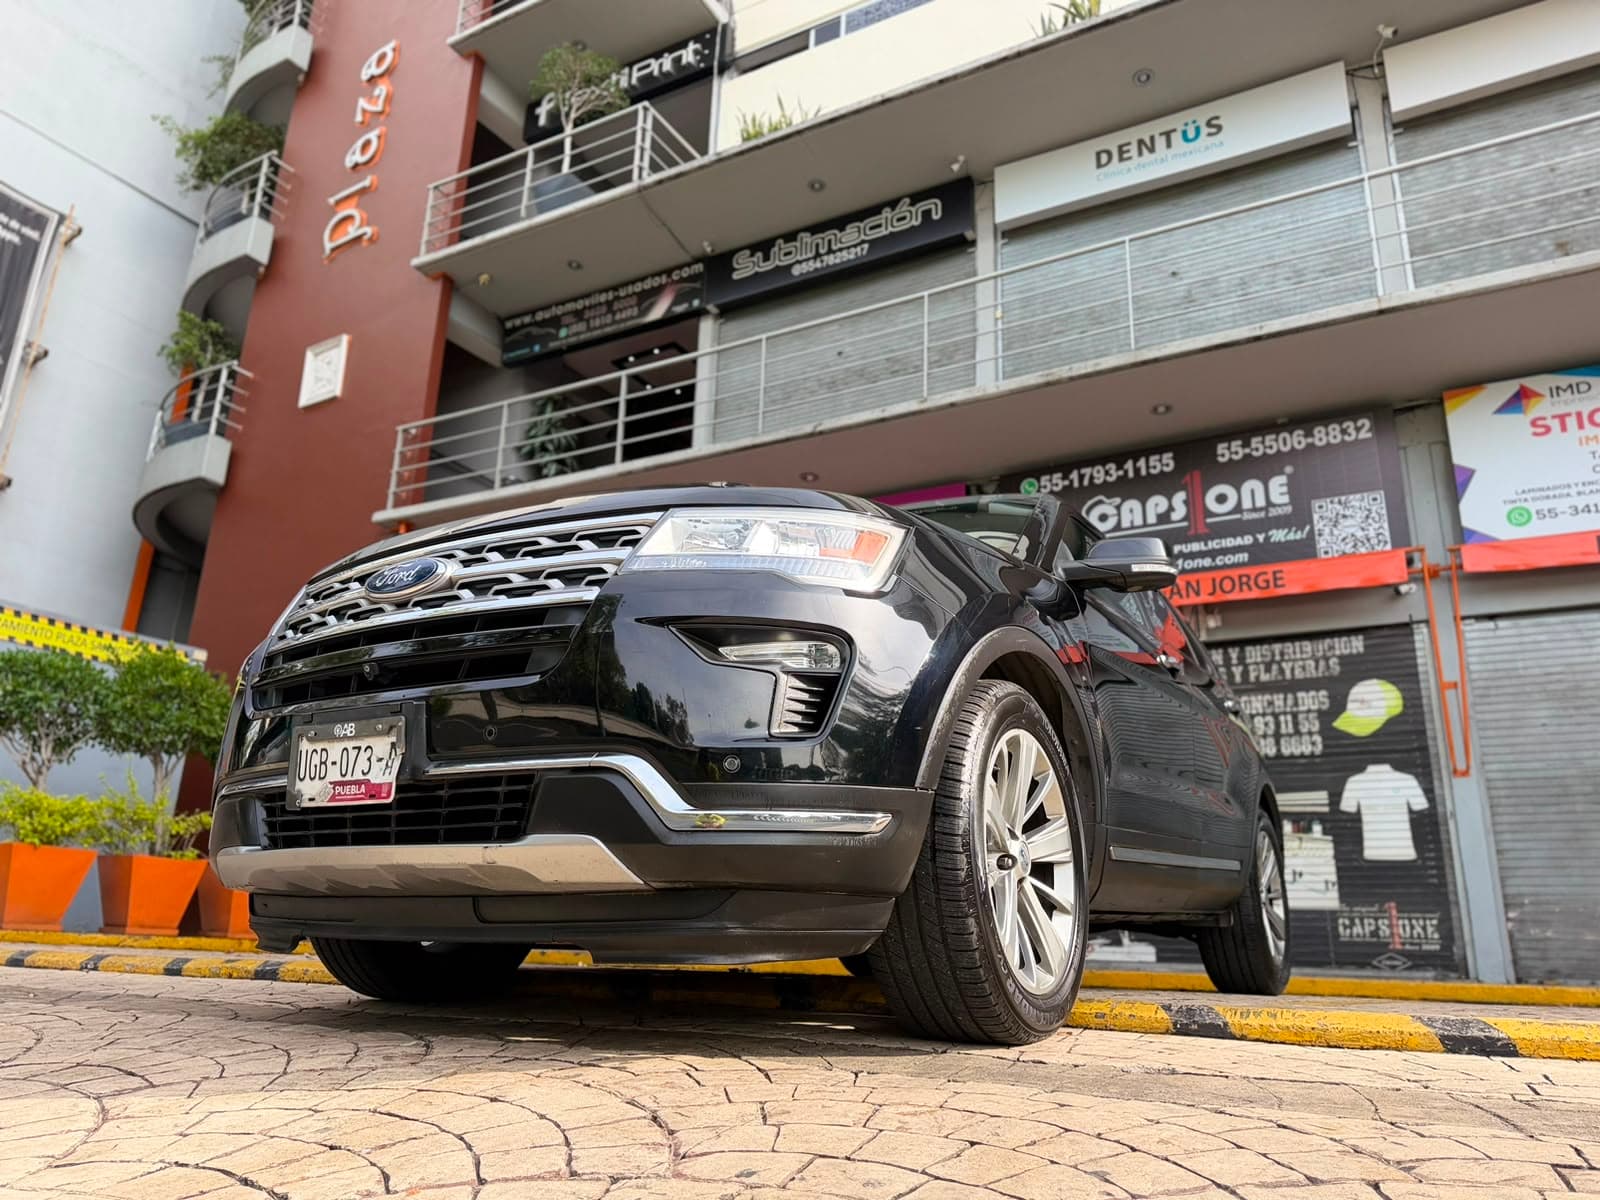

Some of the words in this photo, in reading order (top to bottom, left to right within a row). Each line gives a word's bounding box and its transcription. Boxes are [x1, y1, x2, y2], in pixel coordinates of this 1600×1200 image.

[322, 39, 399, 260] plaza
[1095, 115, 1224, 170] DENTÜS
[732, 198, 943, 280] Sublimación
[1548, 380, 1592, 399] IMD
[1216, 418, 1372, 463] 55-5506-8832
[1039, 452, 1175, 493] 55-1793-1155
[1173, 535, 1253, 554] PUBLICIDAD
[1256, 533, 1266, 544] Y
[375, 562, 423, 587] Ford
[1175, 552, 1249, 571] 1one.com
[1168, 580, 1200, 600] AN
[1208, 570, 1286, 596] JORGE
[0, 617, 54, 641] AMIENTO
[1245, 635, 1365, 664] DISTRIBUCION
[1249, 656, 1341, 682] PLAYERAS
[1240, 689, 1330, 715] ONCHADOS
[335, 784, 366, 795] PUEBLA
